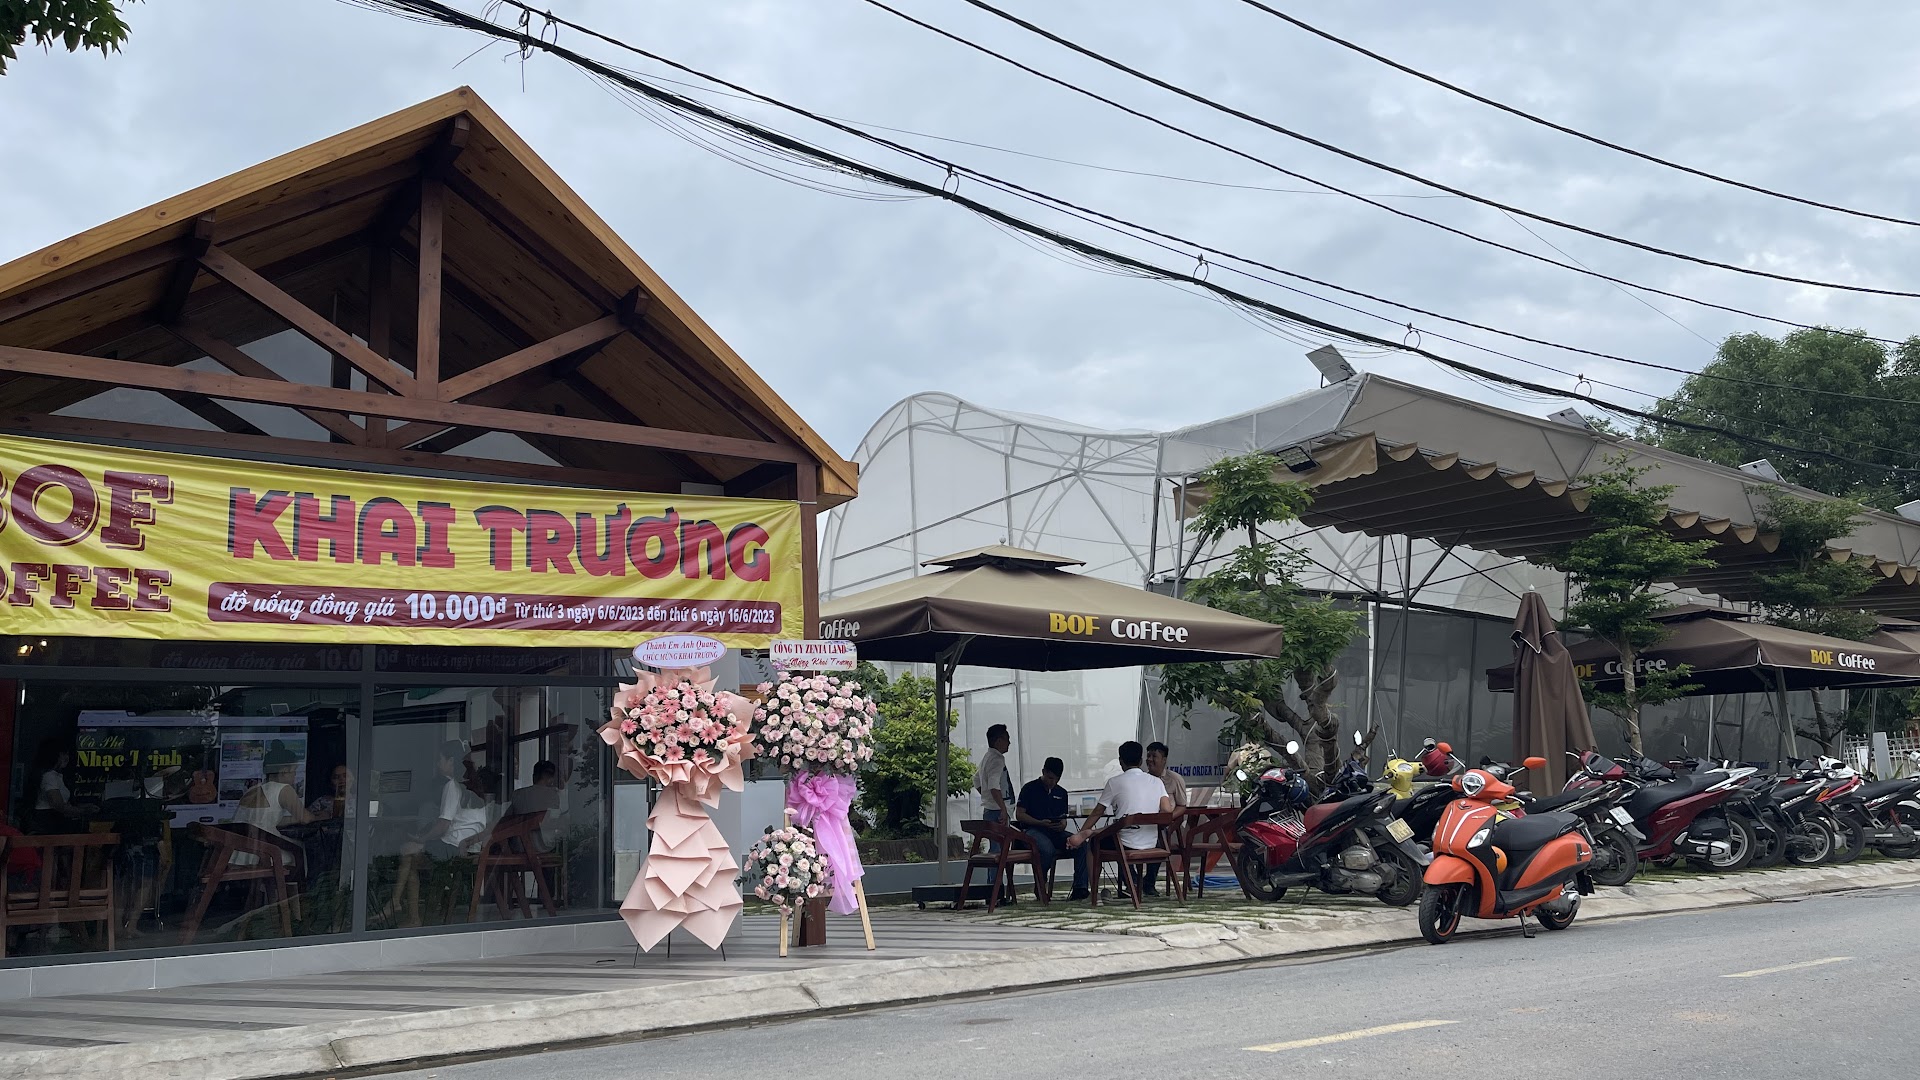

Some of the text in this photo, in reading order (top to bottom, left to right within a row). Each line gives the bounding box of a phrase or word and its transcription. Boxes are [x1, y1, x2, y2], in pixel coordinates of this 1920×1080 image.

[0, 464, 175, 551] OF
[227, 487, 456, 568] KHAI
[220, 589, 251, 612] đồ
[252, 590, 305, 621] uống
[309, 592, 360, 623] đồng
[363, 596, 396, 623] giá
[514, 602, 529, 619] Từ
[532, 602, 555, 619] thứ
[557, 606, 564, 620] 3
[566, 604, 595, 626] ngày
[597, 605, 645, 622] 6/6/2023
[646, 604, 667, 622] đến
[669, 605, 689, 623] thứ
[691, 608, 698, 623] 6
[700, 607, 726, 627] ngày
[728, 608, 775, 624] 16/6/2023
[1049, 612, 1100, 636] BOF
[681, 640, 695, 649] Anh
[696, 640, 718, 651] Quang
[794, 644, 803, 654] TY
[1810, 649, 1834, 666] BOF
[1574, 663, 1597, 678] OF
[76, 750, 125, 772] Nhạc
[1192, 765, 1212, 776] ORDER
